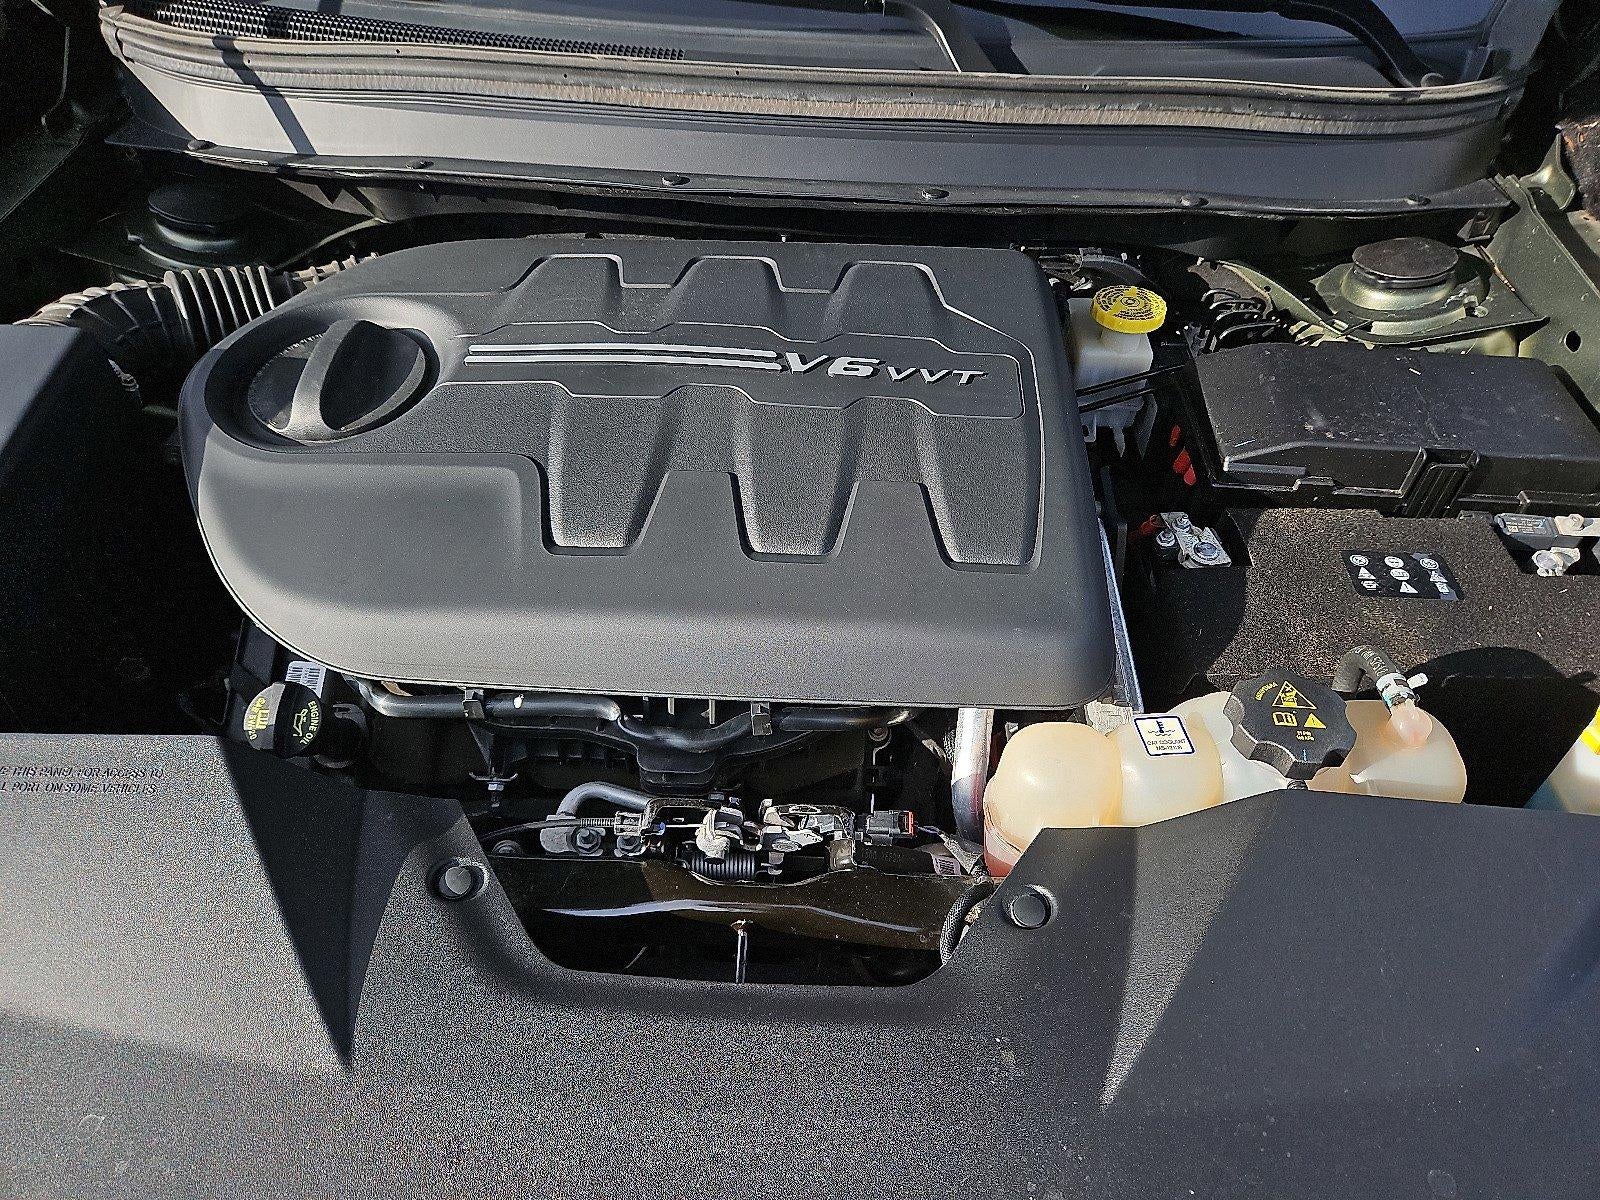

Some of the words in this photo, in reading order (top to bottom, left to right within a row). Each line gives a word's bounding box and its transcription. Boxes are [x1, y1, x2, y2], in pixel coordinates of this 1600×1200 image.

[785, 352, 881, 377] V6
[886, 366, 986, 385] VVT
[307, 700, 320, 732] ENGINE
[299, 732, 314, 745] OIL
[12, 766, 38, 776] THIS
[40, 767, 74, 777] PANEL
[77, 767, 101, 777] FOR
[101, 767, 146, 778] ACCESS
[149, 768, 164, 778] TO
[12, 782, 40, 793] PORT
[44, 783, 63, 793] ON
[64, 783, 100, 794] SOME
[102, 784, 157, 794] VEHICLES
